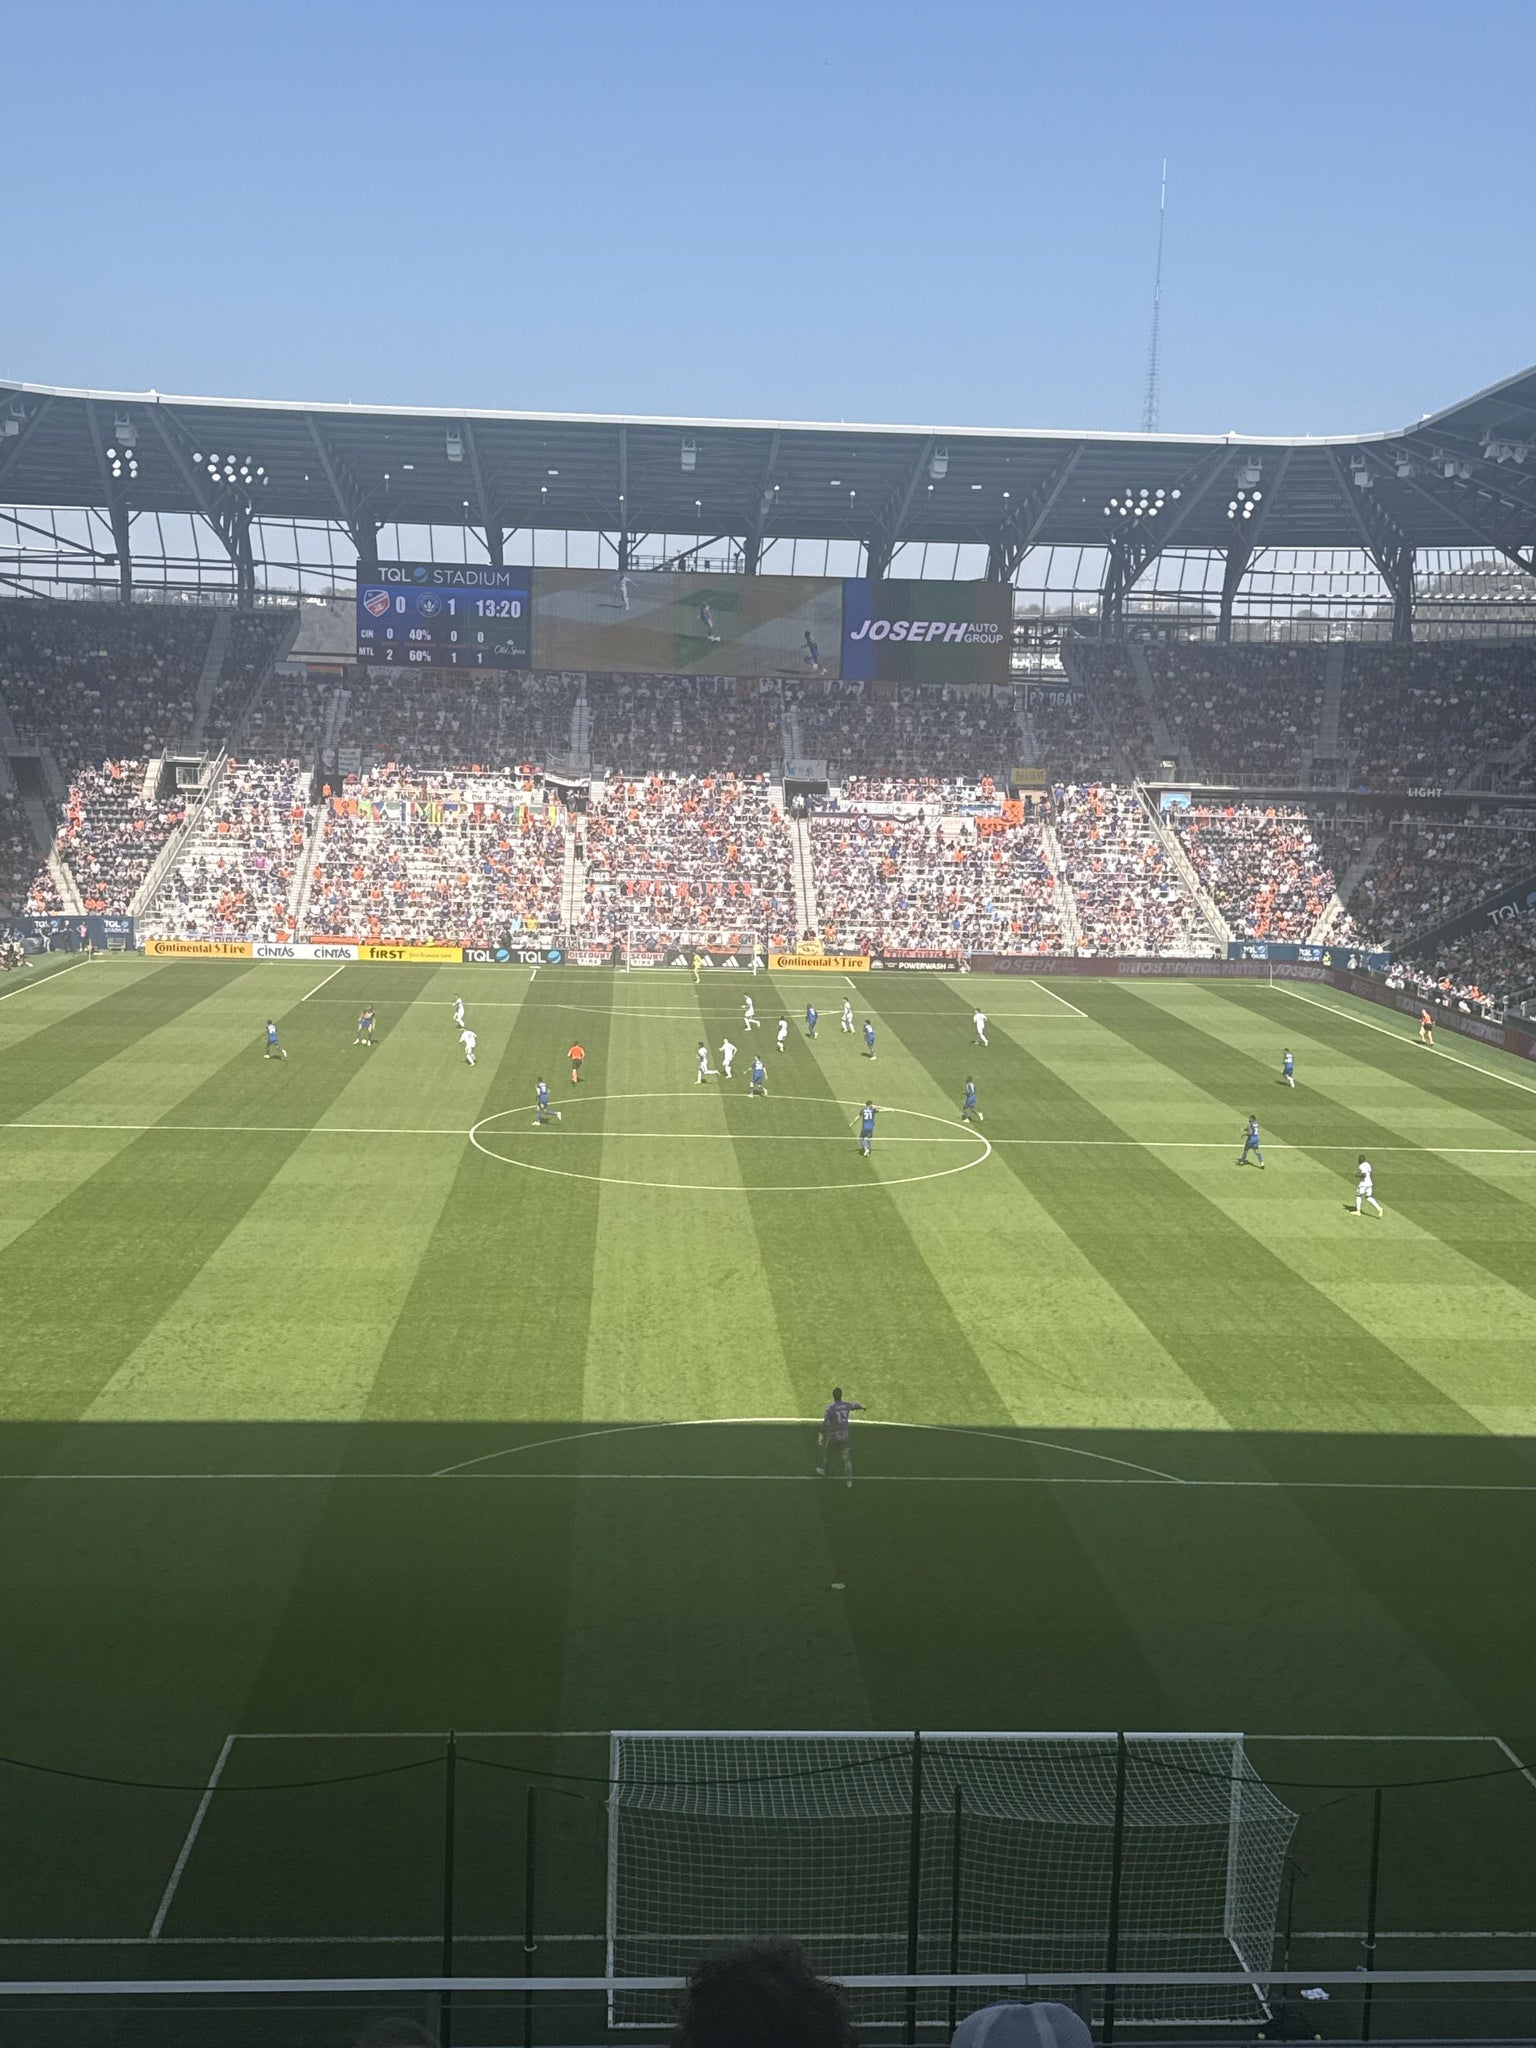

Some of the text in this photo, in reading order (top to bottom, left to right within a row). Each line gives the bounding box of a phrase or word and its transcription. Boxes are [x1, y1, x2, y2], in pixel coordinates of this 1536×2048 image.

[377, 567, 511, 586] TQL STADIUM
[395, 596, 406, 614] 0
[447, 599, 456, 616] 1
[476, 599, 521, 619] 13:20
[850, 619, 968, 643] JOSEPH
[967, 623, 999, 633] AUTO
[360, 627, 484, 643] CIN 0 40% 0 0
[963, 633, 1004, 644] GROUP
[358, 646, 483, 664] MTL 2 60% 1 1
[1408, 787, 1442, 798] LIGHT
[103, 920, 121, 928] TQL
[154, 942, 246, 954] Continental Tire
[465, 949, 495, 962] TQL
[517, 950, 547, 963] TQL
[567, 950, 613, 960] DISCOUNT
[620, 952, 665, 961] DSCOUNT
[777, 956, 863, 968] Continental Tire
[898, 962, 946, 970] POWERWASH
[863, 1112, 873, 1120] 21
